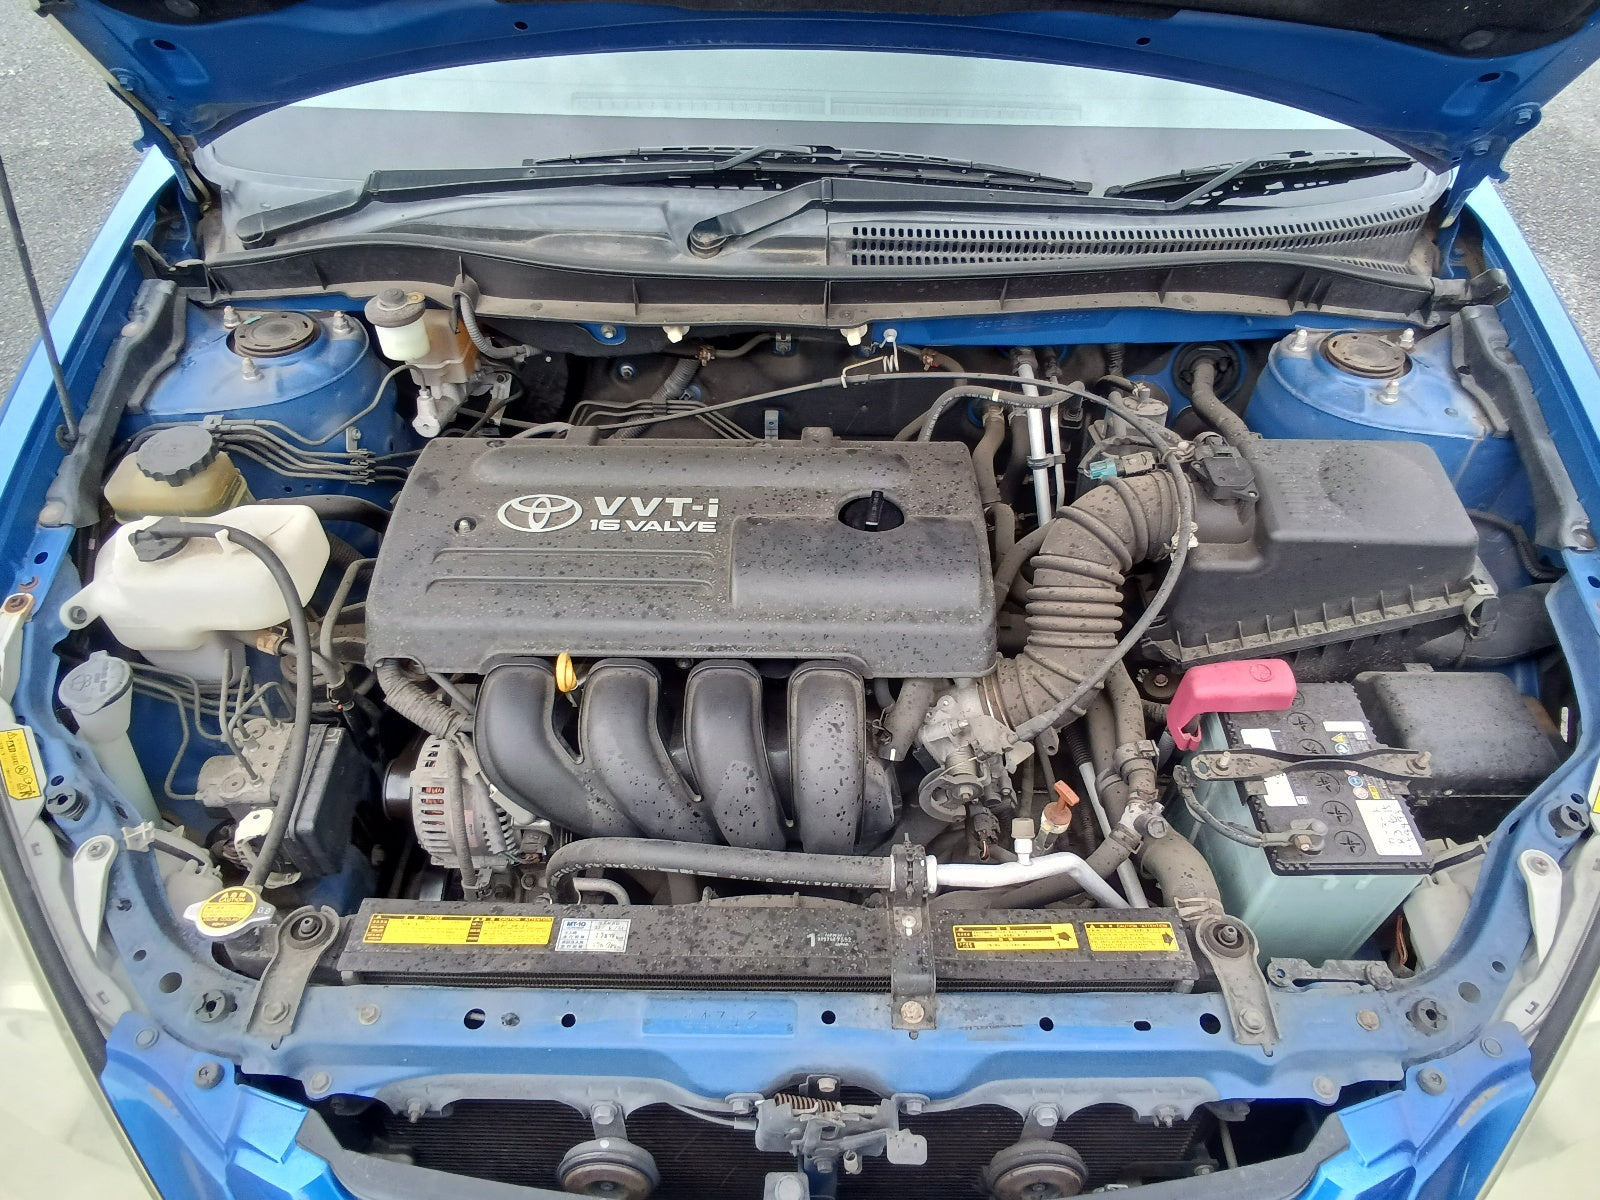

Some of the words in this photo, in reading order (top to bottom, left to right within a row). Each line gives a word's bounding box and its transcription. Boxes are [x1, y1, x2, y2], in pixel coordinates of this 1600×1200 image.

[594, 496, 719, 518] VVT-i
[590, 519, 621, 531] 16
[625, 520, 718, 533] VALVE
